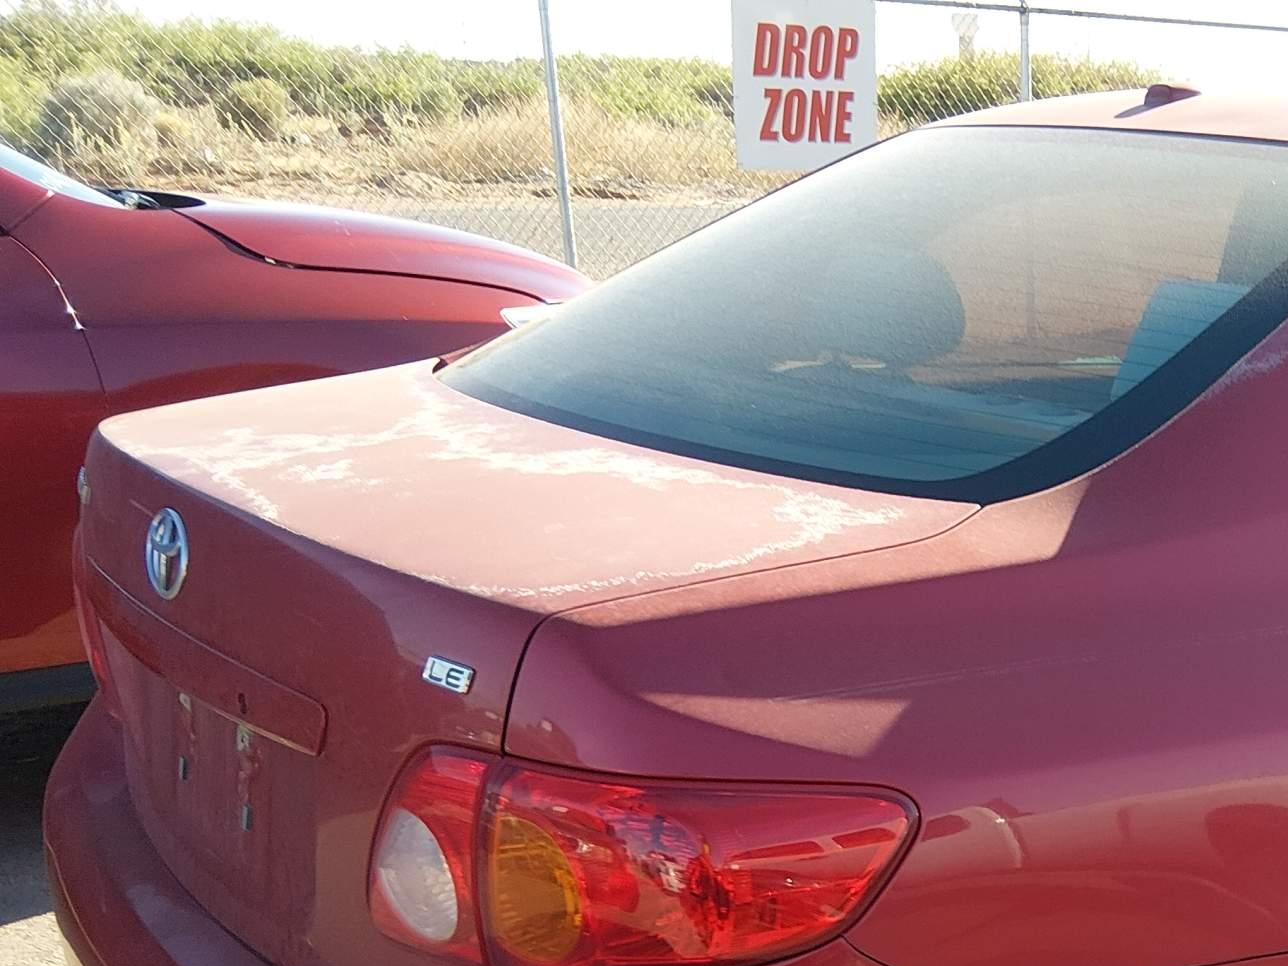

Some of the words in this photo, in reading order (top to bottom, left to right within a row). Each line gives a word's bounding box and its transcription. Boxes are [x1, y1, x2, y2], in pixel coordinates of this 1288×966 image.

[753, 22, 860, 80] DROP
[760, 88, 855, 143] ZONE
[428, 660, 465, 689] LE
